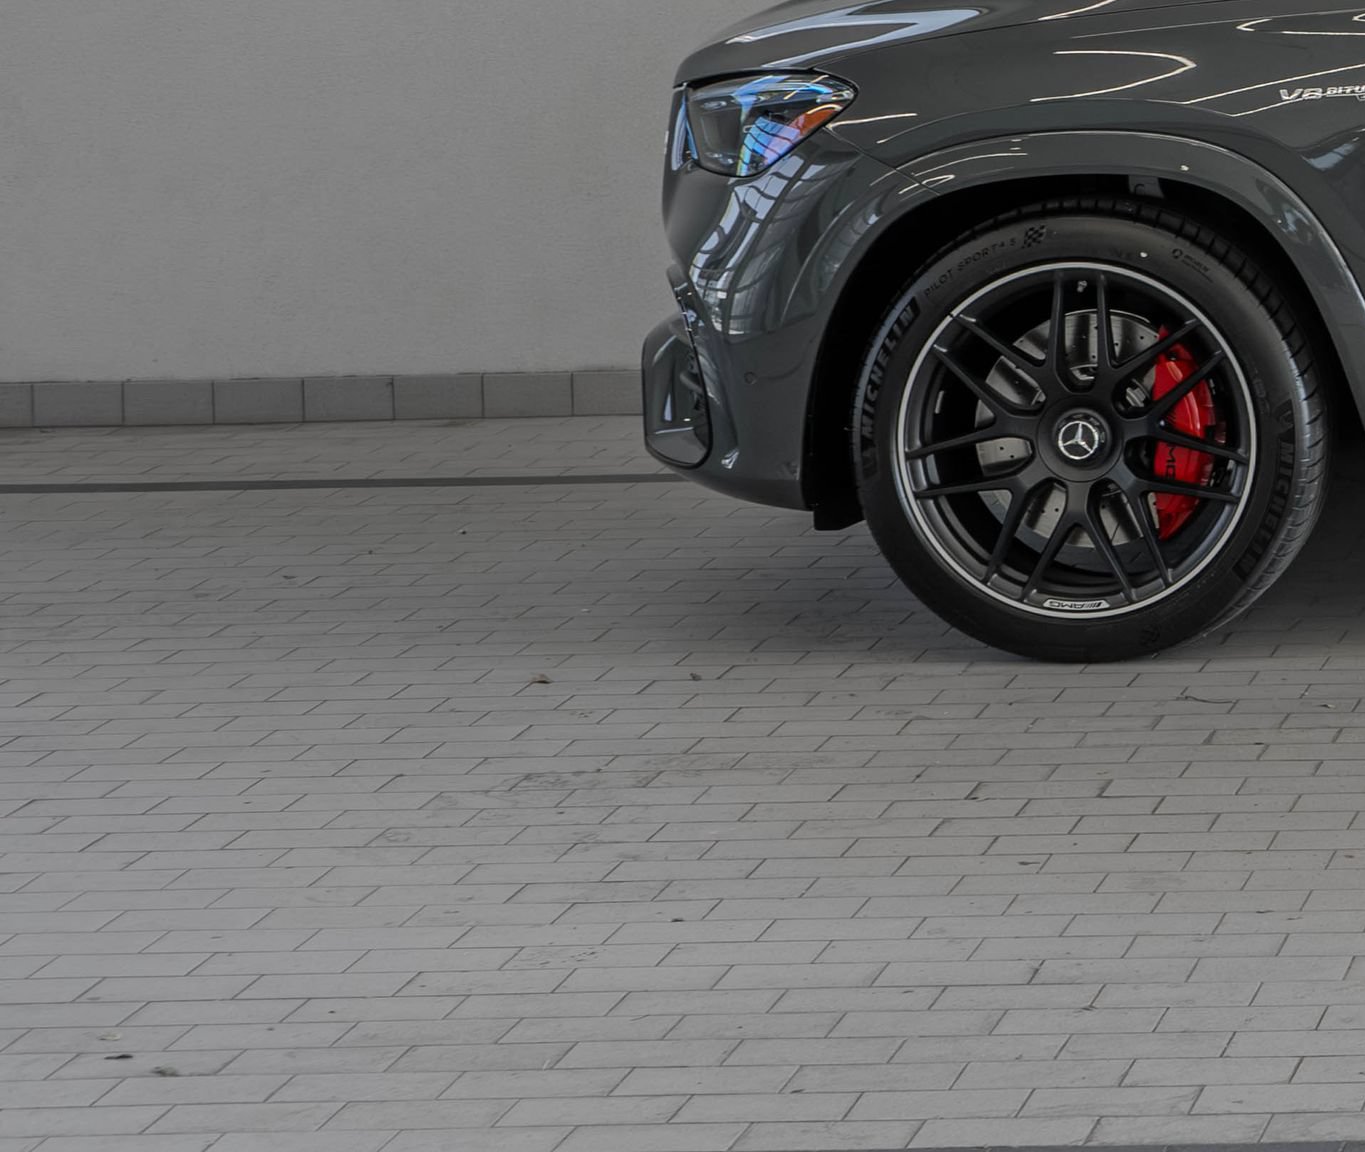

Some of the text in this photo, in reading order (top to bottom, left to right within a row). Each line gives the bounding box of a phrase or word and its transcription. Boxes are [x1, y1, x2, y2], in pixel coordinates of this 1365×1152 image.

[1279, 87, 1323, 101] V8
[923, 268, 953, 297] PILOT
[957, 244, 999, 271] SPORT
[861, 305, 915, 438] MICHELIN
[1237, 440, 1295, 578] MICHELIN
